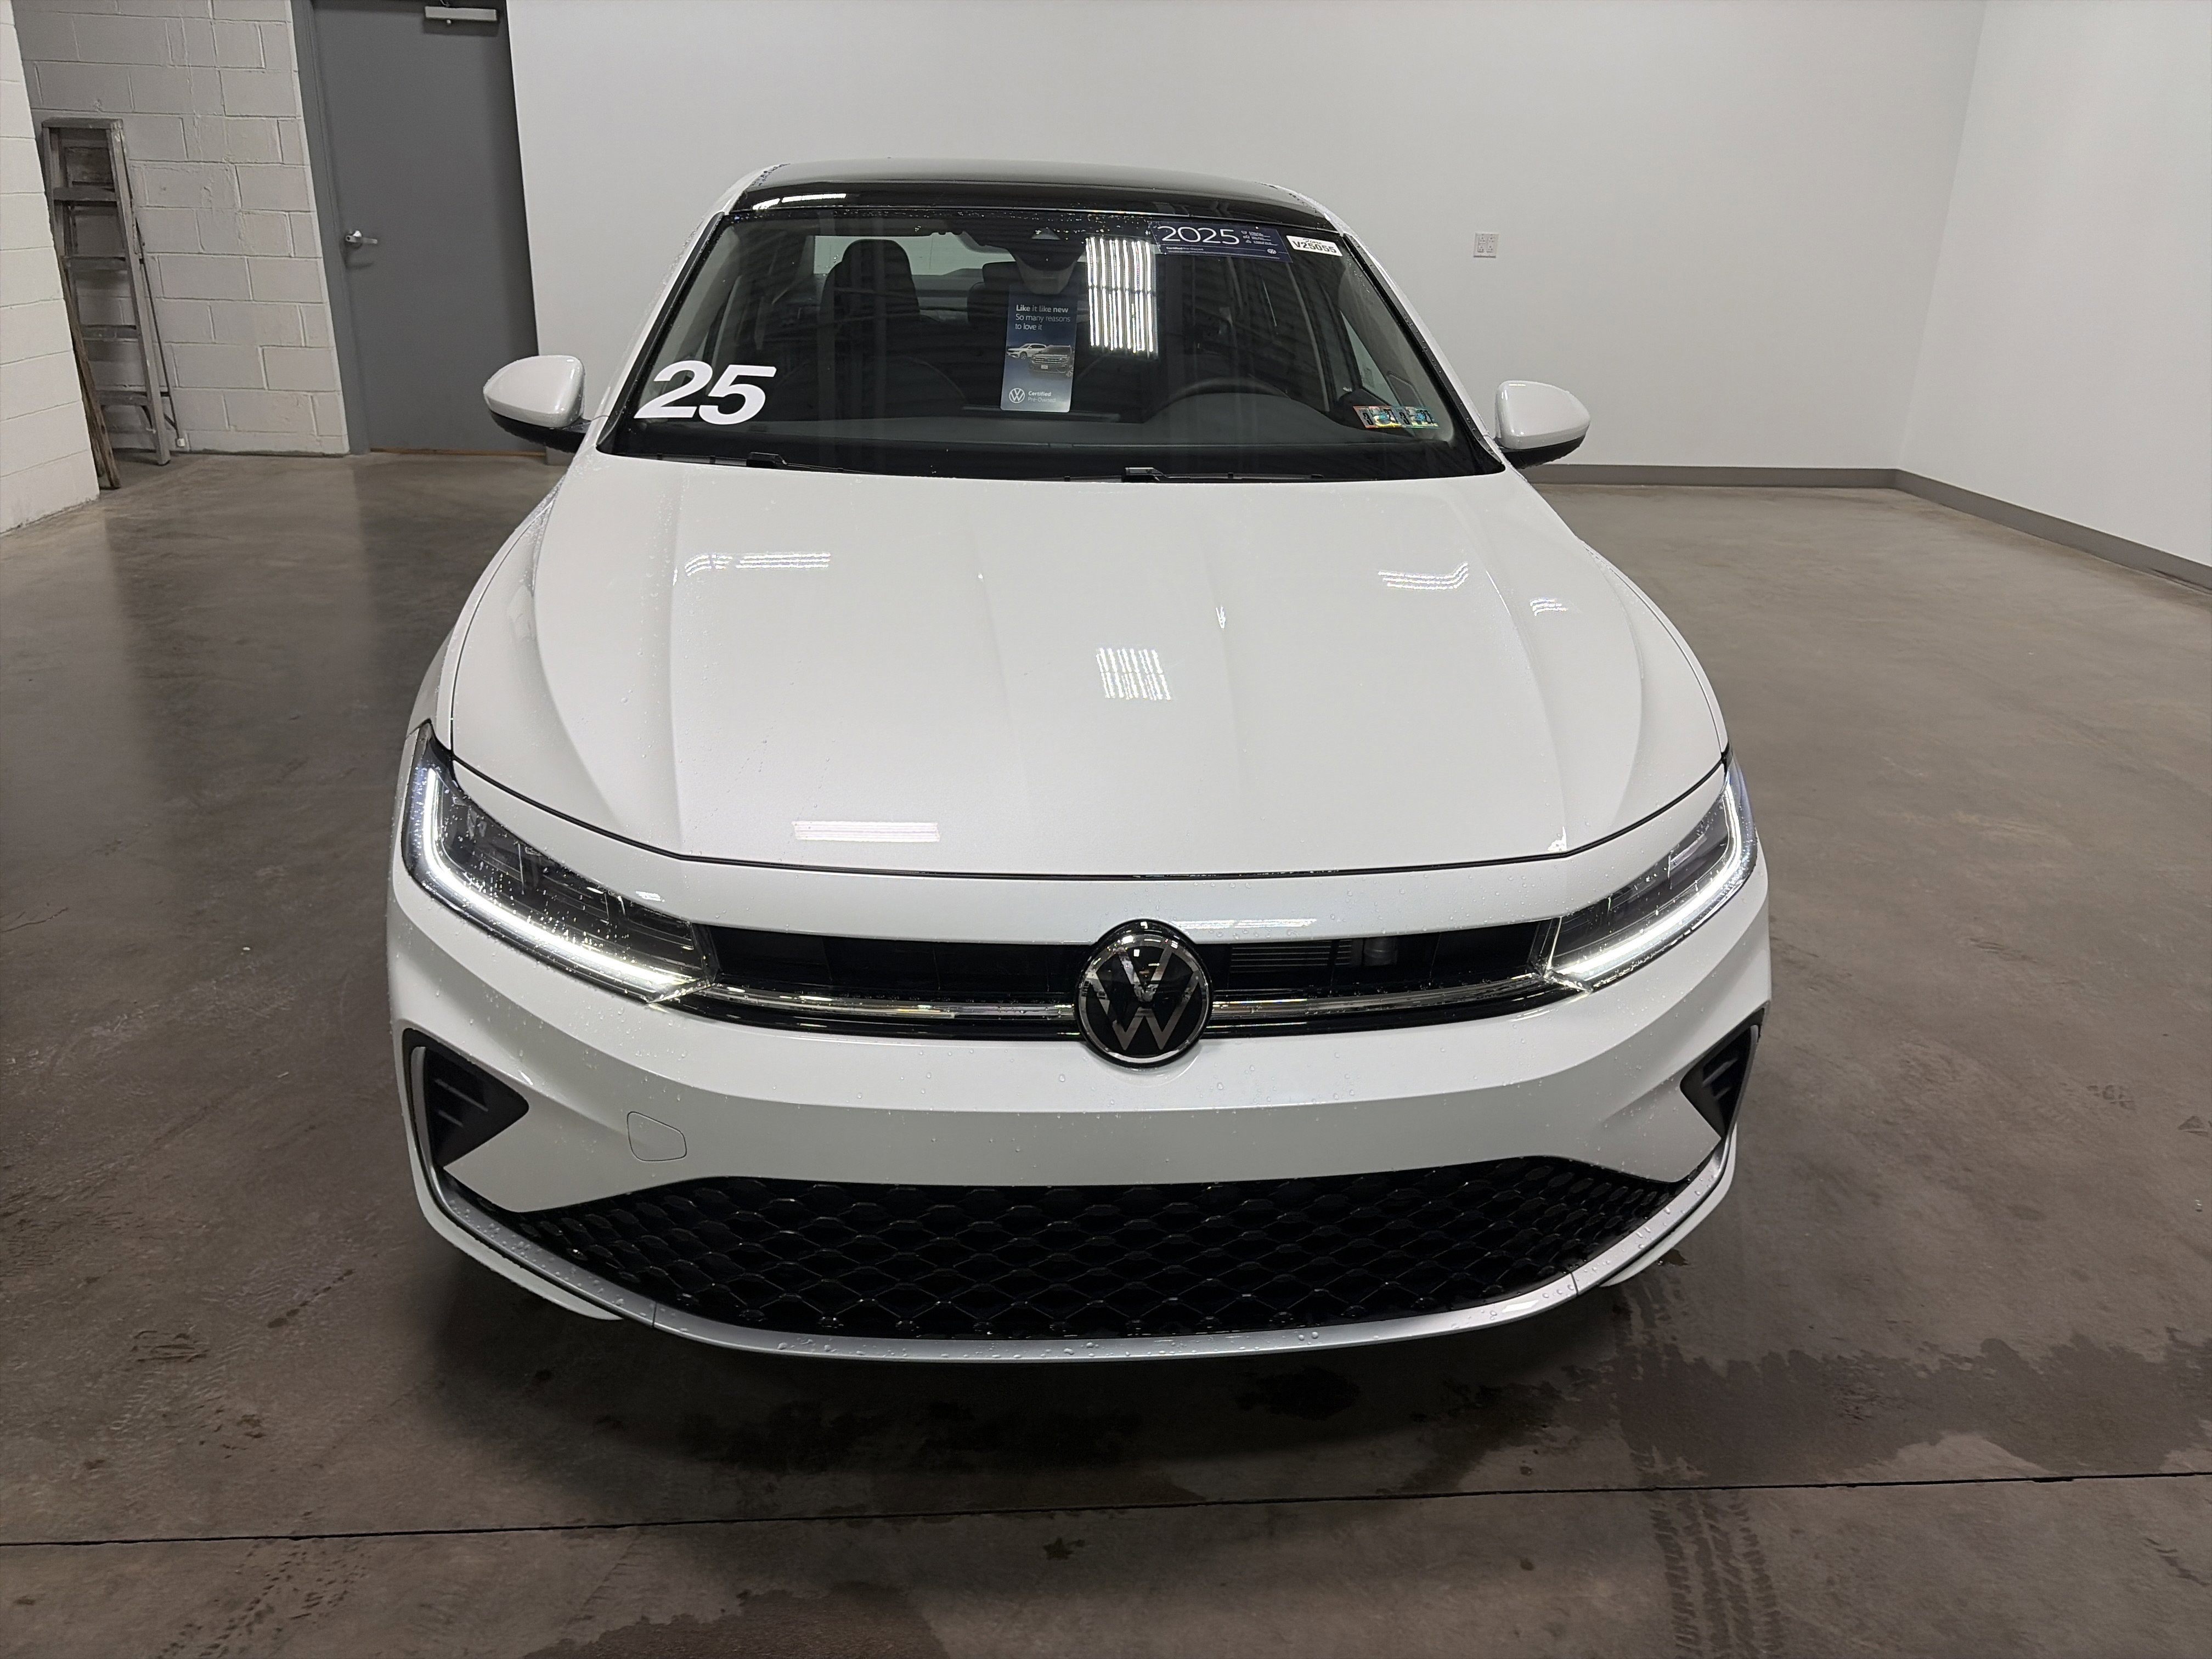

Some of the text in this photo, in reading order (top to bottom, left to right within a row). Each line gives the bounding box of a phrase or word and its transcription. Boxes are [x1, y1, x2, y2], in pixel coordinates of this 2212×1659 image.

[1156, 225, 1240, 245] 2025
[1292, 240, 1337, 253] V25055
[634, 360, 777, 425] 25
[1363, 412, 1374, 425] 3
[1399, 411, 1410, 425] 3
[1086, 943, 1204, 1051] VW
